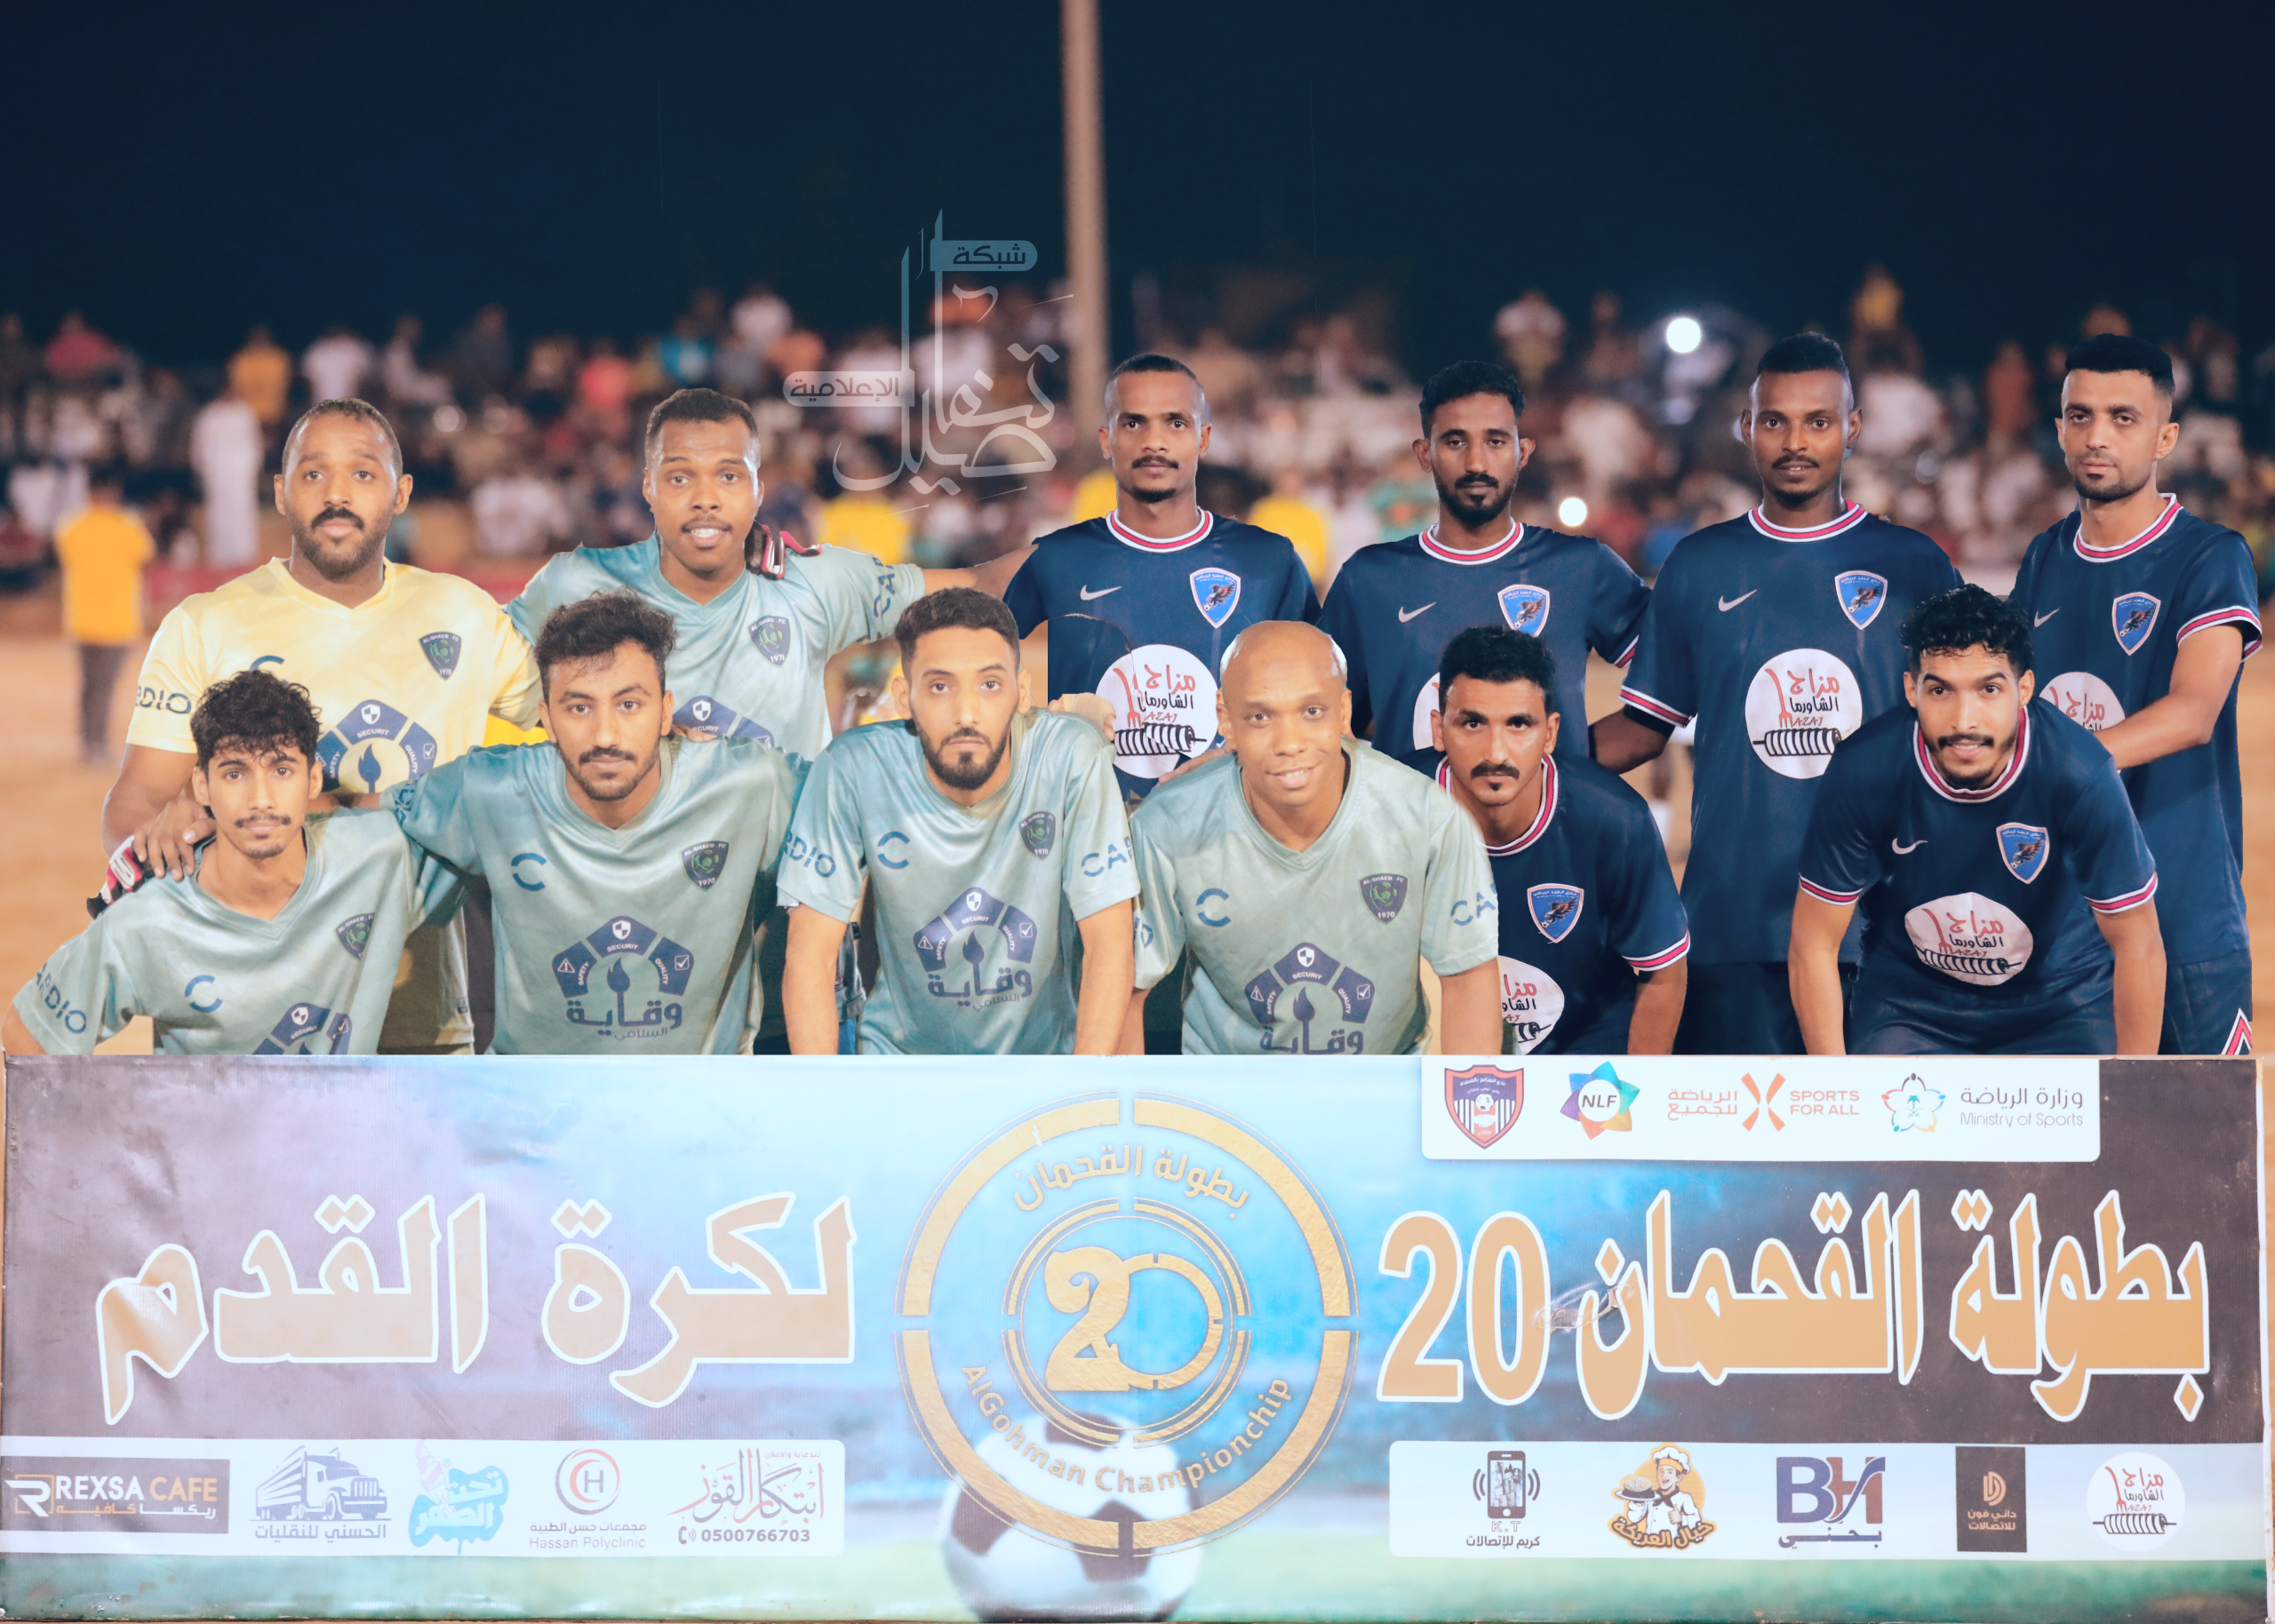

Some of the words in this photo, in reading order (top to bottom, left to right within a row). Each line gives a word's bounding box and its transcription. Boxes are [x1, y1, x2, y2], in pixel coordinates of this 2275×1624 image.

[1144, 664, 1196, 695] مزاج
[1787, 668, 1840, 698] مزاج
[1790, 696, 1839, 714] الشاورما
[2066, 691, 2105, 724] مزاج
[356, 728, 390, 739] SECURIT
[405, 744, 419, 774] QUALITY
[698, 877, 716, 887] 1970
[962, 915, 990, 925] SECURIT
[1946, 910, 2004, 938] مزاج
[606, 943, 639, 952] SECURIT
[937, 936, 946, 960] SAFETY
[1002, 925, 1015, 951] QUALITY
[1949, 934, 2004, 949] الشاورما
[578, 961, 589, 986] SAFETY
[654, 958, 669, 985] QUALITY
[1292, 971, 1322, 980] SECURIT
[928, 967, 1032, 1007] وقاية
[1503, 974, 1537, 1000] مزا
[1266, 991, 1277, 1015] SAFETY
[1338, 988, 1351, 1015] QUALITY
[1501, 998, 1537, 1013] الشاو
[566, 999, 682, 1036] وقاية
[1581, 1095, 1617, 1108] NLF
[1667, 1088, 1738, 1104] الرياضة
[1790, 1090, 1860, 1102] SPORTS
[1960, 1087, 2027, 1110] الرياضة
[2036, 1087, 2084, 1109] وزارة
[1667, 1103, 1738, 1121] للجميع
[1790, 1104, 1824, 1116] FOR
[1827, 1104, 1860, 1116] ALL
[1960, 1111, 2014, 1128] Ministry
[2017, 1112, 2033, 1126] of
[2036, 1112, 2084, 1128] Sports
[1014, 1145, 1144, 1212] القحمان
[1153, 1148, 1250, 1219] بطولة
[95, 1193, 491, 1425] القدم
[542, 1191, 857, 1408] لكرة
[1377, 1211, 1552, 1406] 20
[1576, 1189, 1925, 1421] القحمان
[1949, 1189, 2211, 1421] بطولة
[1044, 1246, 1225, 1391] 20
[962, 1365, 1085, 1486] AlGohman
[1094, 1378, 1292, 1493] Championchip
[56, 1476, 145, 1500] REXSA
[149, 1477, 218, 1501] CAFE
[2122, 1467, 2164, 1491] مزاج
[1776, 1457, 1886, 1524] BH
[2124, 1488, 2164, 1502] الشاورما
[56, 1503, 137, 1517] كافيه
[140, 1503, 216, 1519] ريكسا
[1967, 1509, 1989, 1519] فون
[1991, 1509, 2017, 1522] داني
[255, 1524, 318, 1543] للنقليات
[324, 1524, 387, 1543] الحسني
[530, 1522, 567, 1534] الطبية
[569, 1522, 596, 1534] حسن
[599, 1521, 647, 1533] مجمعات
[701, 1529, 810, 1542] 0500766703
[1675, 1521, 1713, 1548] خيال
[1968, 1521, 2016, 1531] للاتصالات
[530, 1537, 579, 1548] Hassan
[583, 1536, 646, 1550] Polyclinic
[1466, 1535, 1513, 1549] للإتصالات
[1516, 1535, 1540, 1549] كريم
